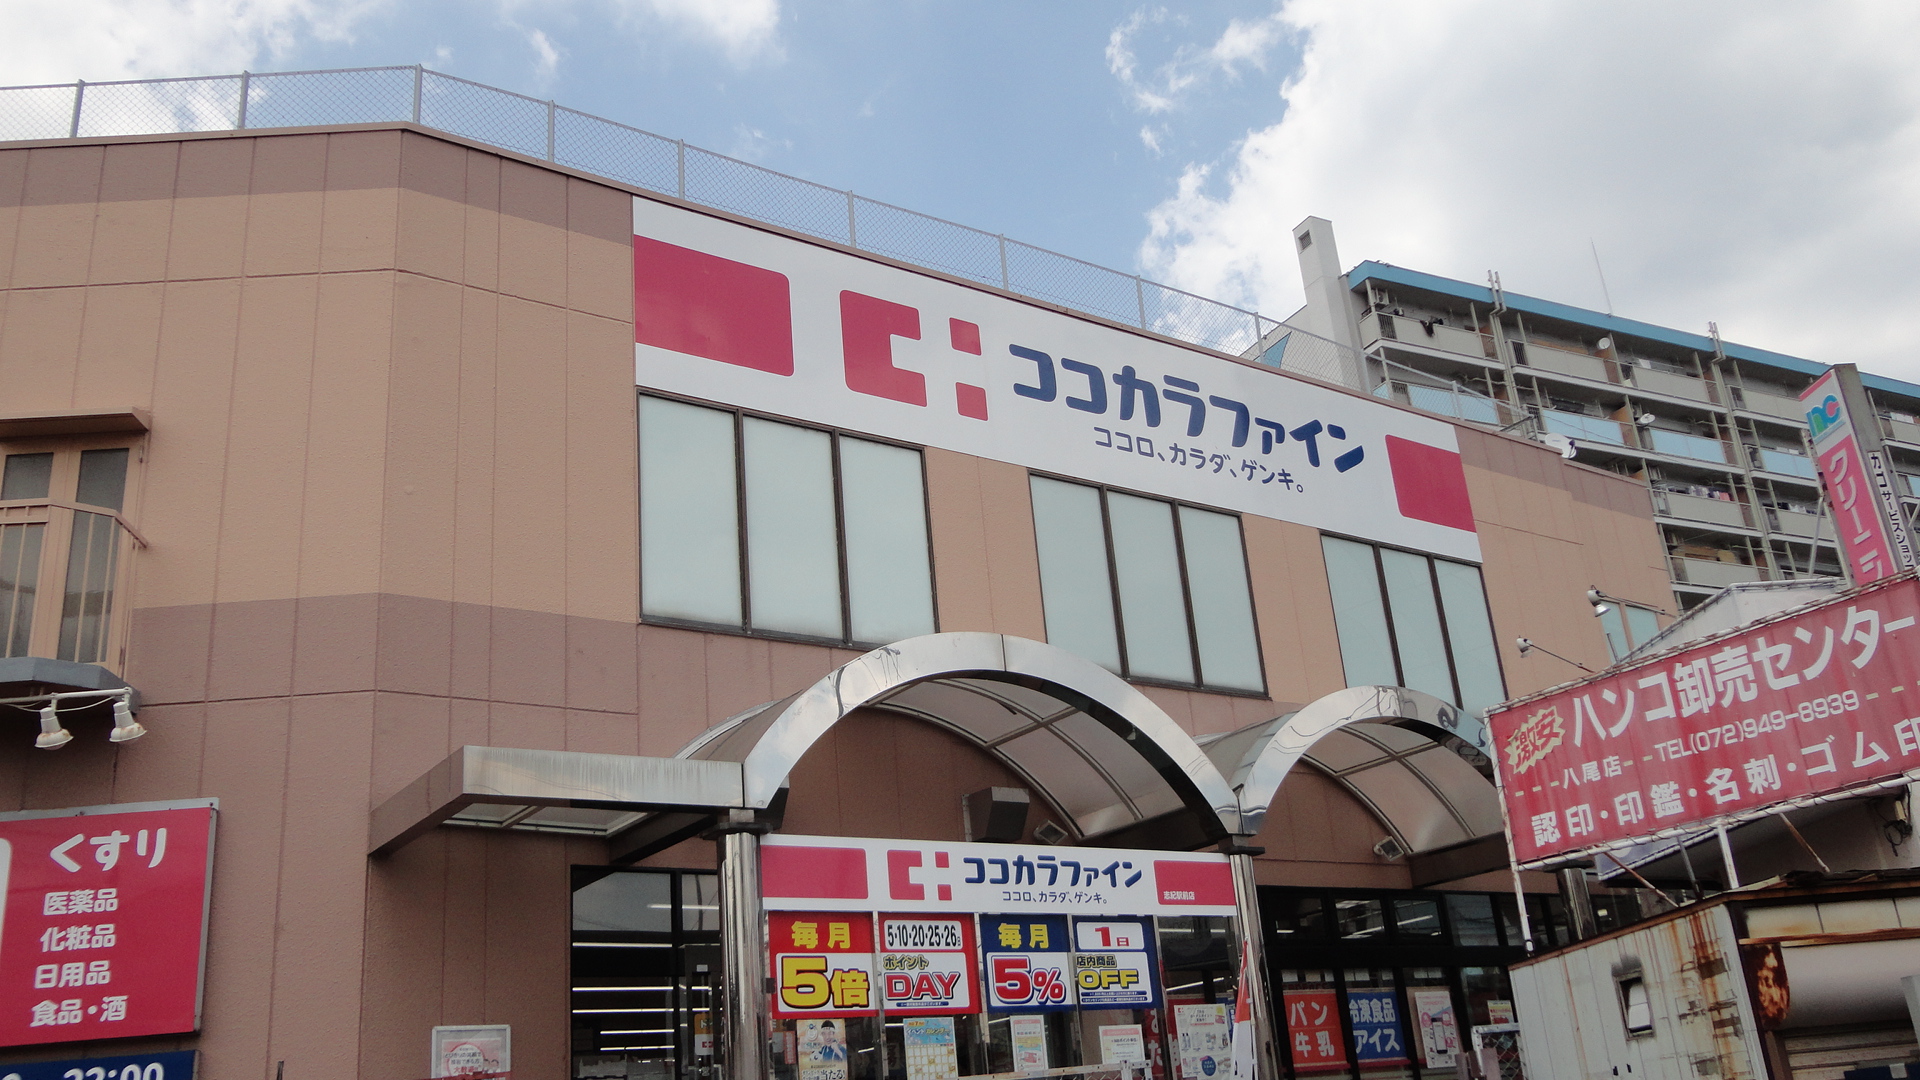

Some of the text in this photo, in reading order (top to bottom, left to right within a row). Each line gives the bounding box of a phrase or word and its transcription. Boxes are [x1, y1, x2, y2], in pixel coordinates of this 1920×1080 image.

[1009, 343, 1364, 473] ココカラファイン
[1093, 426, 1305, 494] ココロ、カラダ、ゲンキ。
[1870, 453, 1915, 568] カコサービスショッ
[1573, 605, 1916, 747] ハンコ卸売センター
[1507, 711, 1561, 771] 激安
[1562, 689, 1860, 790] 八尾店 TEL(072)949-8939
[49, 827, 168, 873] くすり
[963, 854, 1142, 888] ココカラファイン
[42, 888, 119, 916] 医薬品
[1002, 890, 1108, 904] ココロ、カラダ、ゲンキ。
[39, 923, 117, 953] 化粧品
[791, 920, 851, 949] 毎月
[998, 922, 1050, 949] 毎月
[1094, 926, 1130, 947] 1日
[33, 960, 112, 990] 日用品
[883, 953, 929, 971] ポイント
[1075, 954, 1117, 968] 店内商品
[781, 955, 870, 1009] 5倍
[884, 971, 962, 1001] DAY
[991, 954, 1067, 1004] 5%
[1077, 968, 1139, 990] OFF
[29, 994, 129, 1028] 食品・酒
[1290, 1000, 1328, 1026] パン
[1295, 1030, 1335, 1058] 牛乳
[1353, 1028, 1401, 1054] アイス
